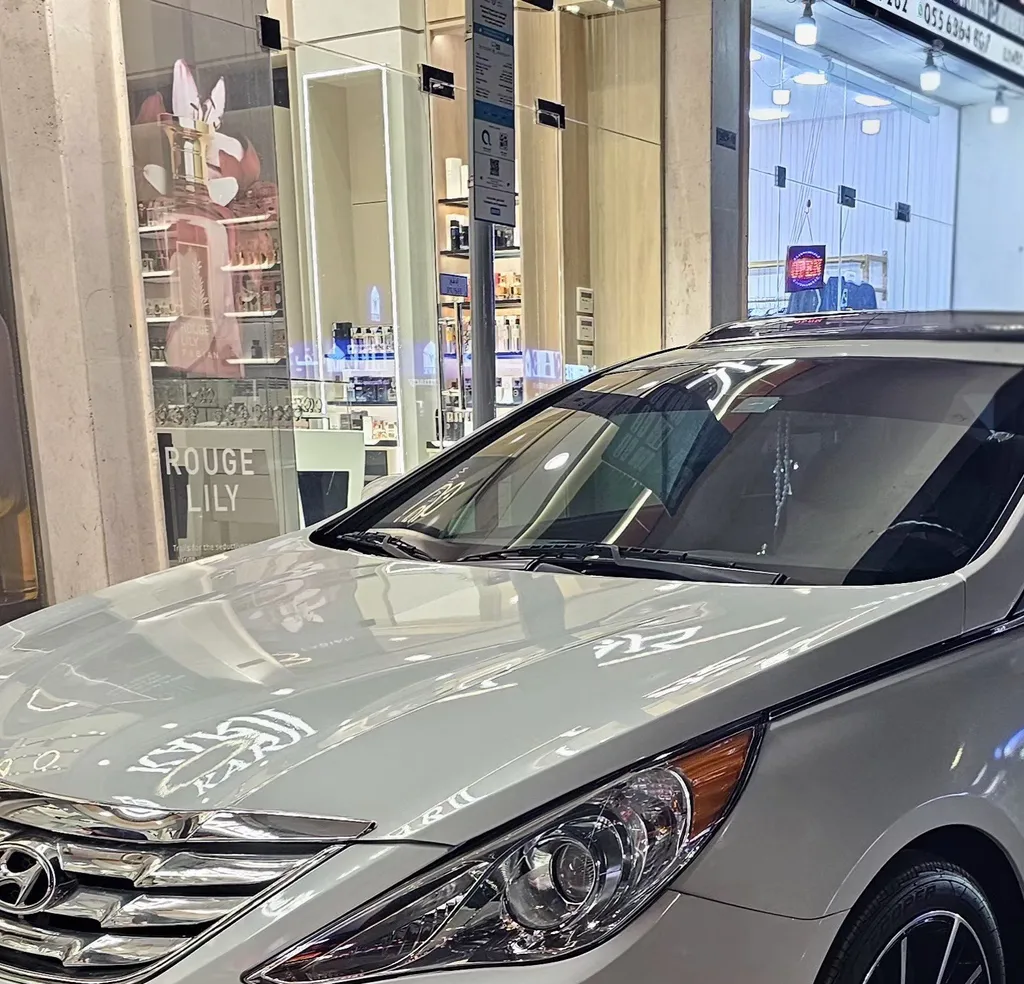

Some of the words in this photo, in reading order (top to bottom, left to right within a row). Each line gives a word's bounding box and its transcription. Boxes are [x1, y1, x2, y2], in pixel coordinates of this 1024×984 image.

[924, 3, 944, 31] 055
[164, 446, 255, 476] ROUGE
[186, 484, 239, 512] LILY
